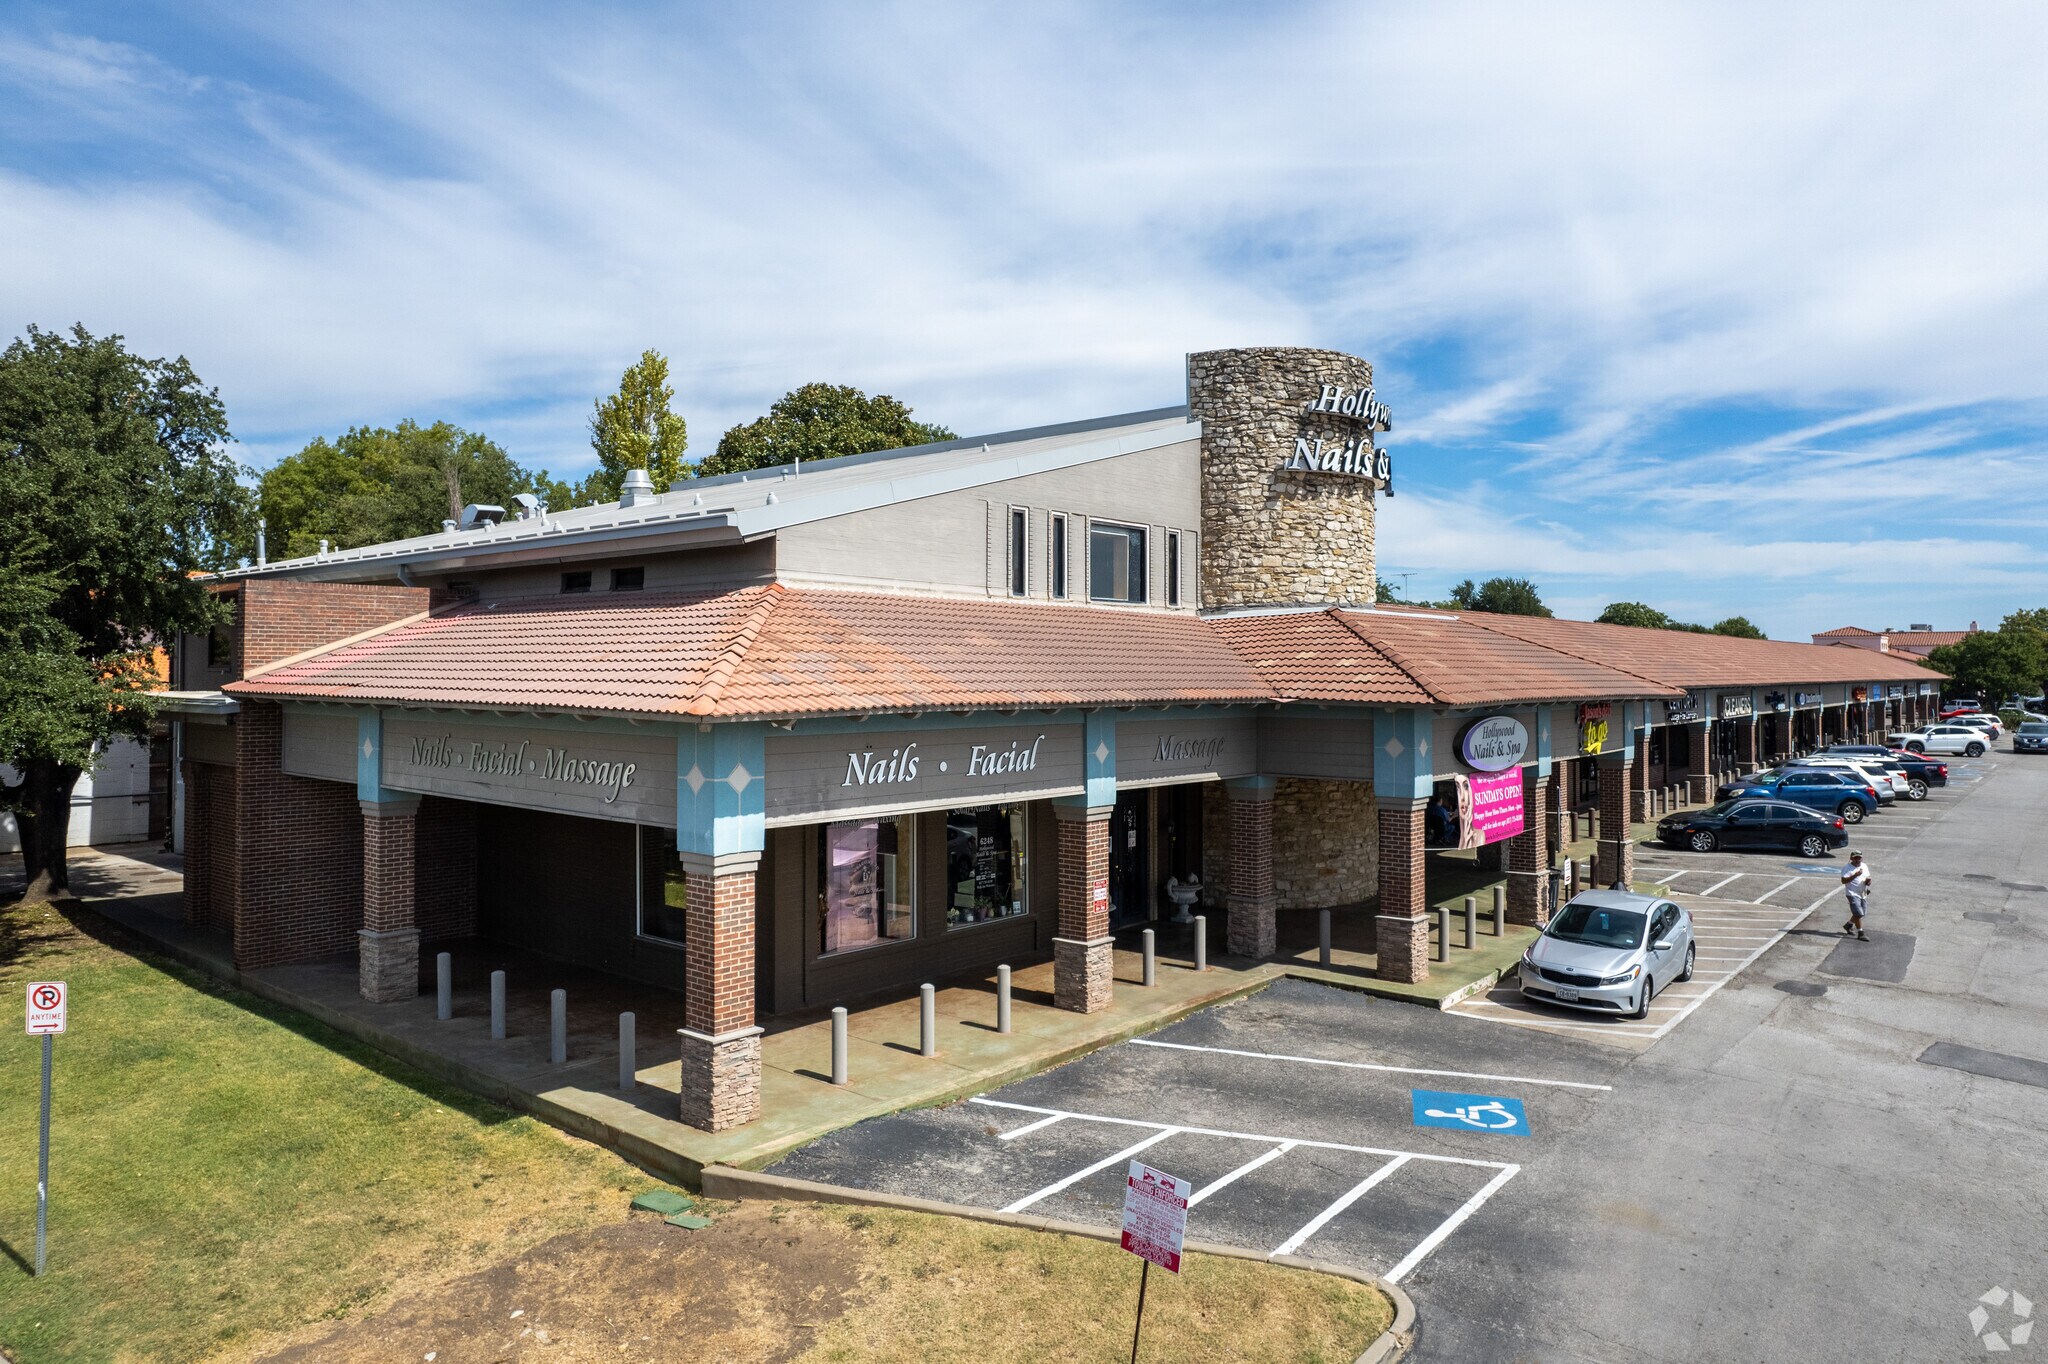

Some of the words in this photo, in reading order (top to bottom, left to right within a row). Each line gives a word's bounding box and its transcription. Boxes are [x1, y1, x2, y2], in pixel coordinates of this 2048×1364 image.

[1314, 384, 1391, 430] Hollyw
[1287, 438, 1373, 478] Nails
[1724, 696, 1752, 717] CLEANERS
[1482, 721, 1517, 744] Hollywood
[842, 742, 920, 787] Nails
[966, 735, 1046, 777] Facial
[1153, 735, 1226, 770] Massage
[1473, 739, 1495, 760] Nails
[1496, 741, 1504, 757] &
[1507, 740, 1521, 762] Spa
[409, 733, 453, 768] Nails
[468, 740, 530, 776] Facial
[540, 748, 637, 804] Massage
[1504, 784, 1522, 800] OPEN!
[31, 1013, 62, 1021] ANYTIME
[1132, 1178, 1154, 1195] TOWING
[1155, 1188, 1184, 1208] ENFORCED
